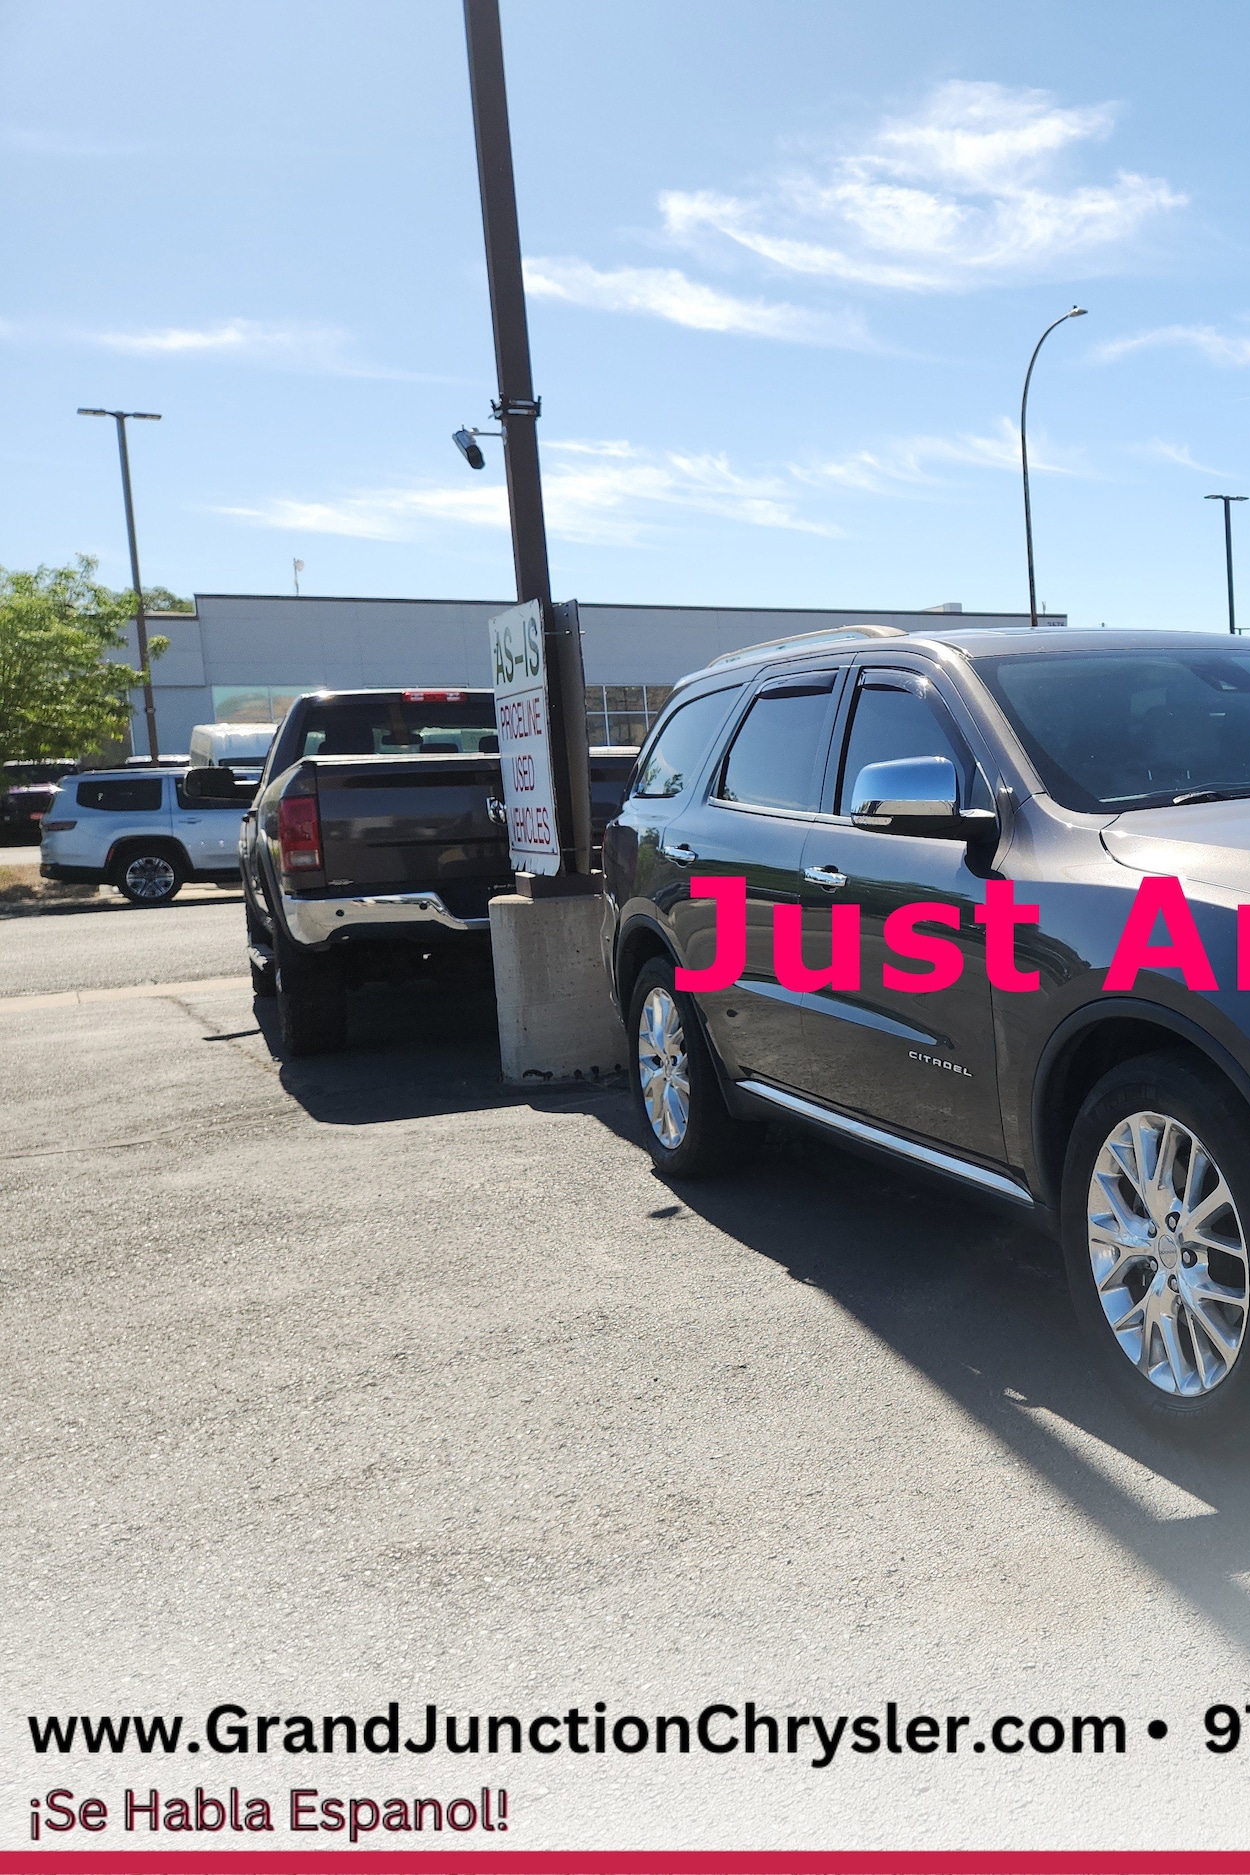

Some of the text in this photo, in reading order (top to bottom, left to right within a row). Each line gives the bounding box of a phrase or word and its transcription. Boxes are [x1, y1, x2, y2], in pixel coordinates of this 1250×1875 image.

[495, 616, 540, 686] AS-IS
[500, 697, 543, 742] PRICELINE
[512, 754, 536, 793] USED
[511, 806, 551, 845] VEHICLES
[908, 1050, 973, 1077] CITADEL
